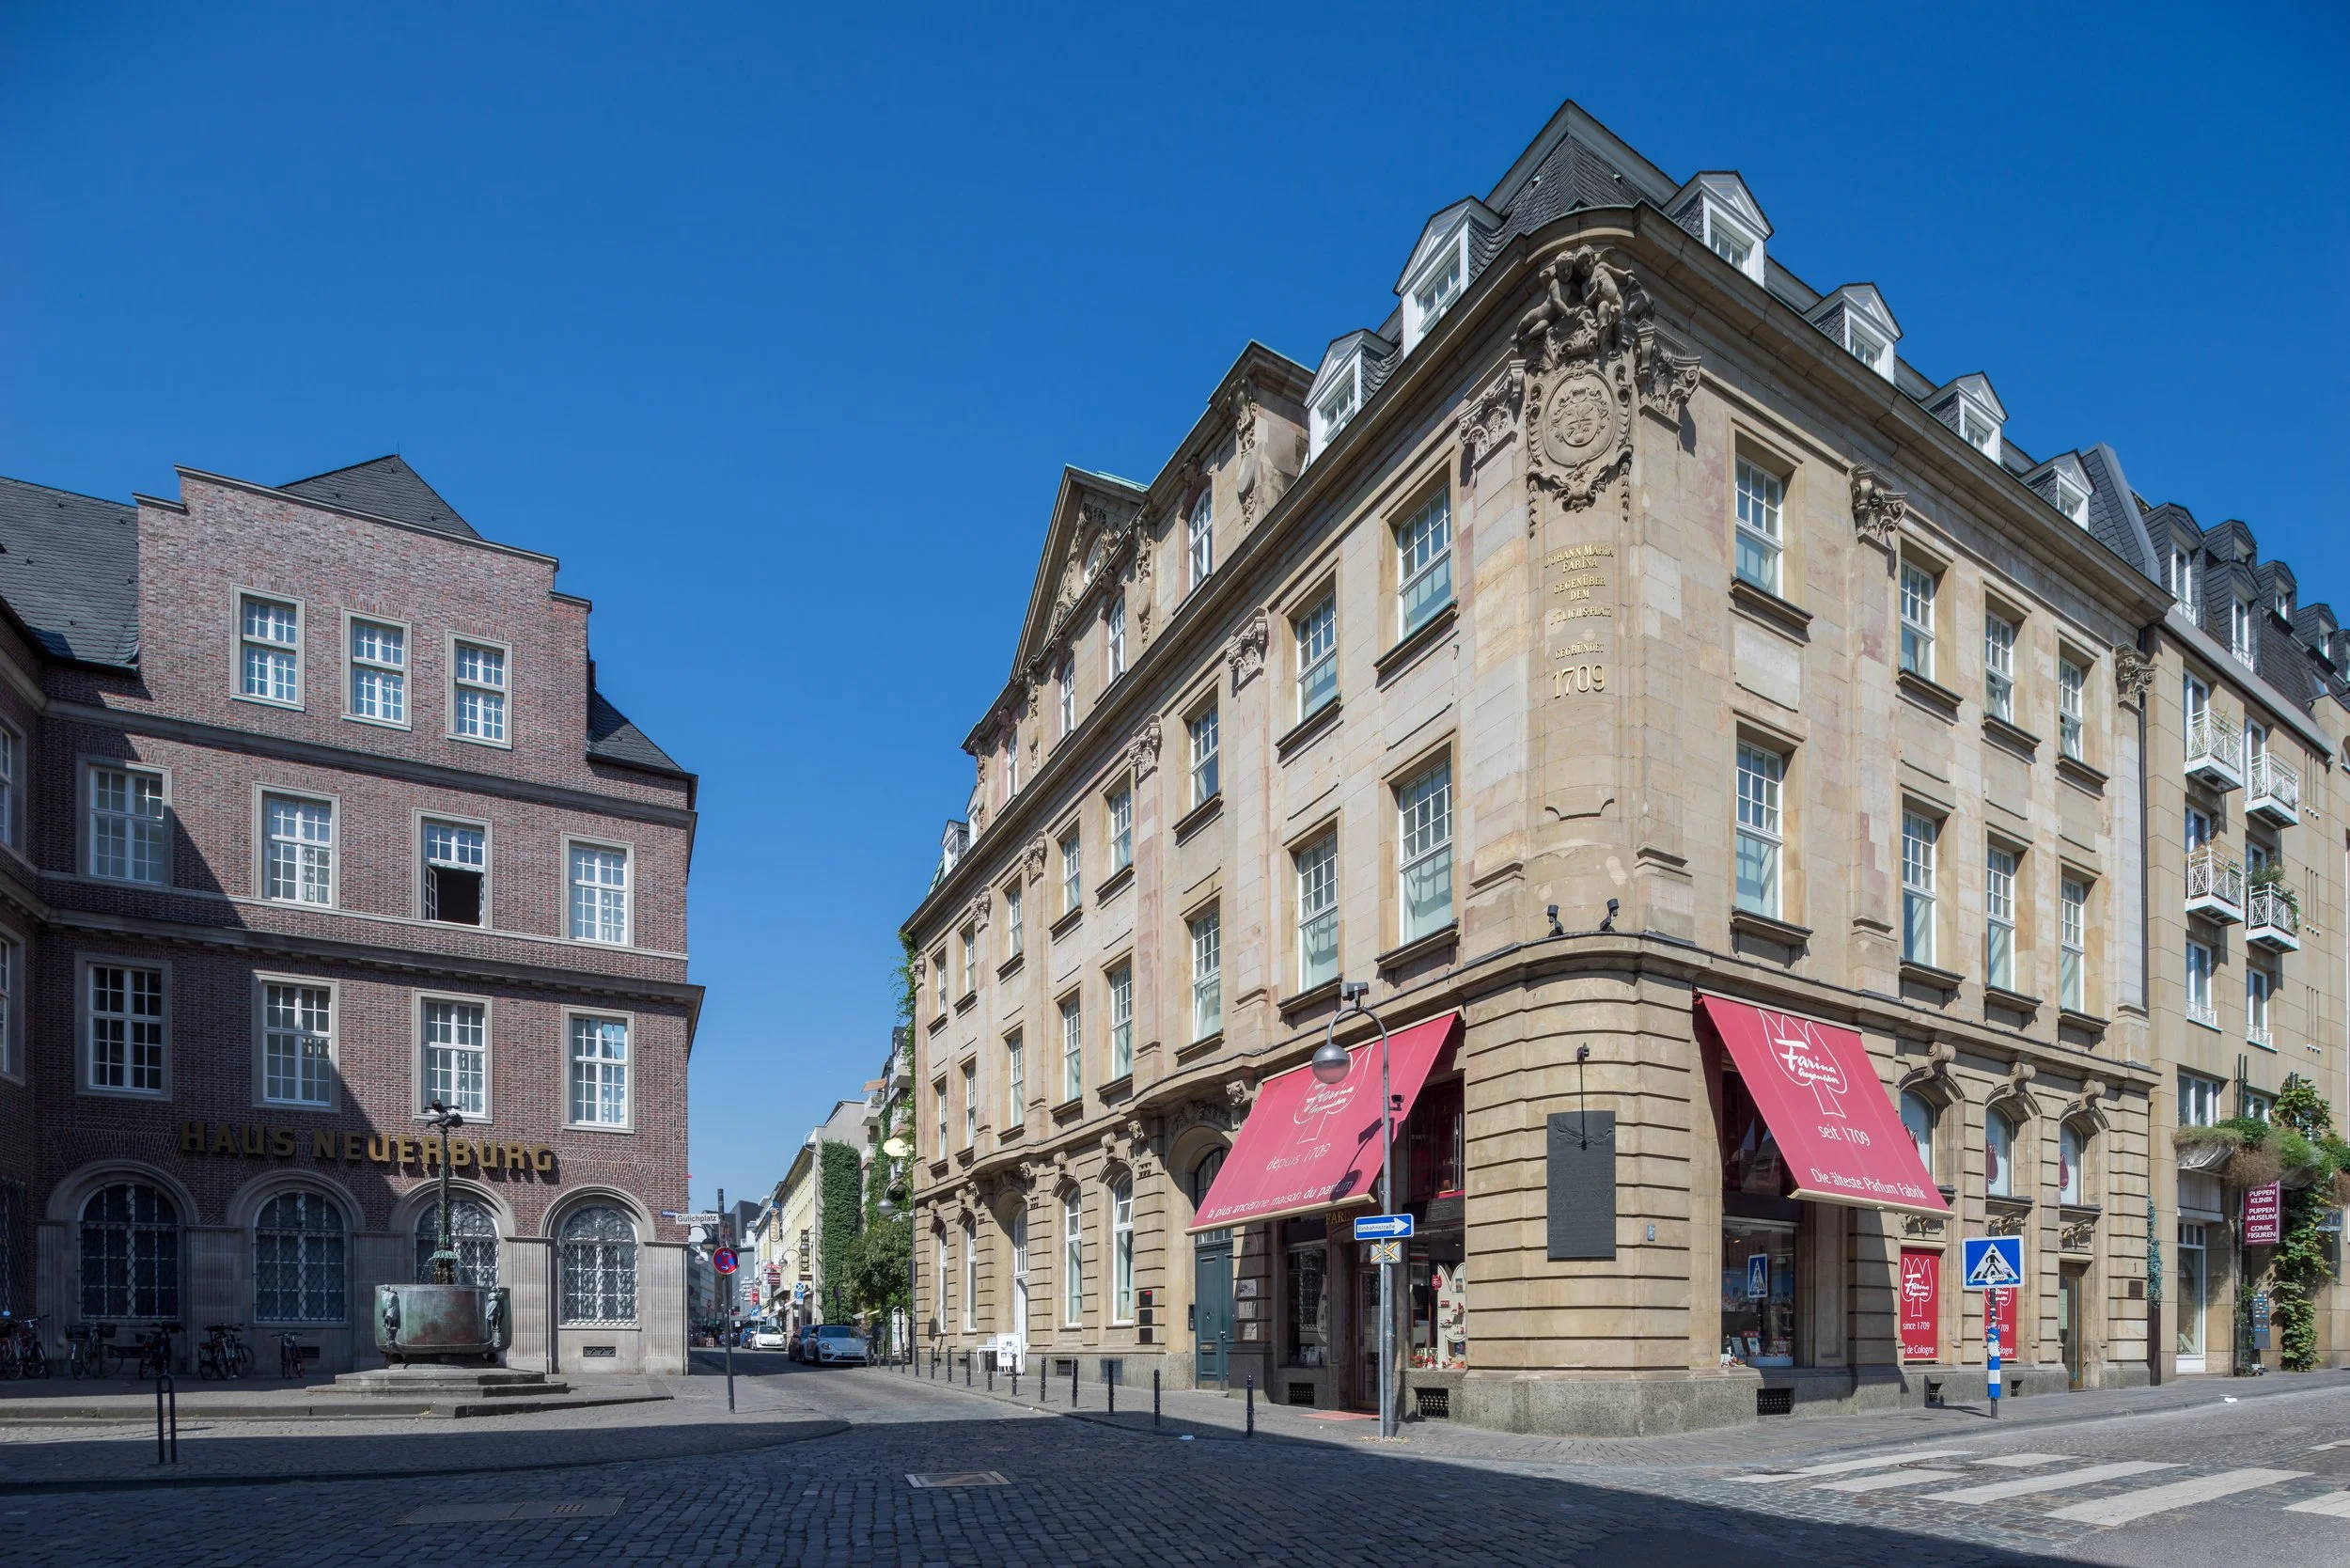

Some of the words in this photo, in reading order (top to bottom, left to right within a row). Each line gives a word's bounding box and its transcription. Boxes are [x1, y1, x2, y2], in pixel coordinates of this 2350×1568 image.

[1554, 574, 1606, 594] GEGENÜBER
[1571, 588, 1590, 602] DEM
[1556, 641, 1605, 659] GEGRÜNDET
[1553, 665, 1605, 699] 1709
[1774, 1038, 1837, 1074] Farina
[1818, 1123, 1841, 1140] seit
[1841, 1127, 1870, 1146] 1709
[180, 1121, 296, 1156] HAUS
[312, 1132, 553, 1171] NEUERBURG
[1266, 1154, 1301, 1171] depuis
[1304, 1142, 1331, 1162] 1709
[1810, 1168, 1831, 1184] Die
[1830, 1172, 1864, 1190] älteste
[1863, 1177, 1899, 1195] Parfum
[1897, 1183, 1927, 1200] Fabrik
[2248, 1189, 2276, 1198] PUPPEN
[1214, 1206, 1231, 1220] plus
[1270, 1191, 1302, 1207] maison
[1304, 1185, 1317, 1200] du
[1316, 1180, 1354, 1200] parfum
[677, 1215, 717, 1223] Gülichplatz
[1903, 1322, 1916, 1330] since
[1917, 1322, 1930, 1330] 1709
[1906, 1344, 1914, 1354] de
[1914, 1344, 1935, 1356] Cologne
